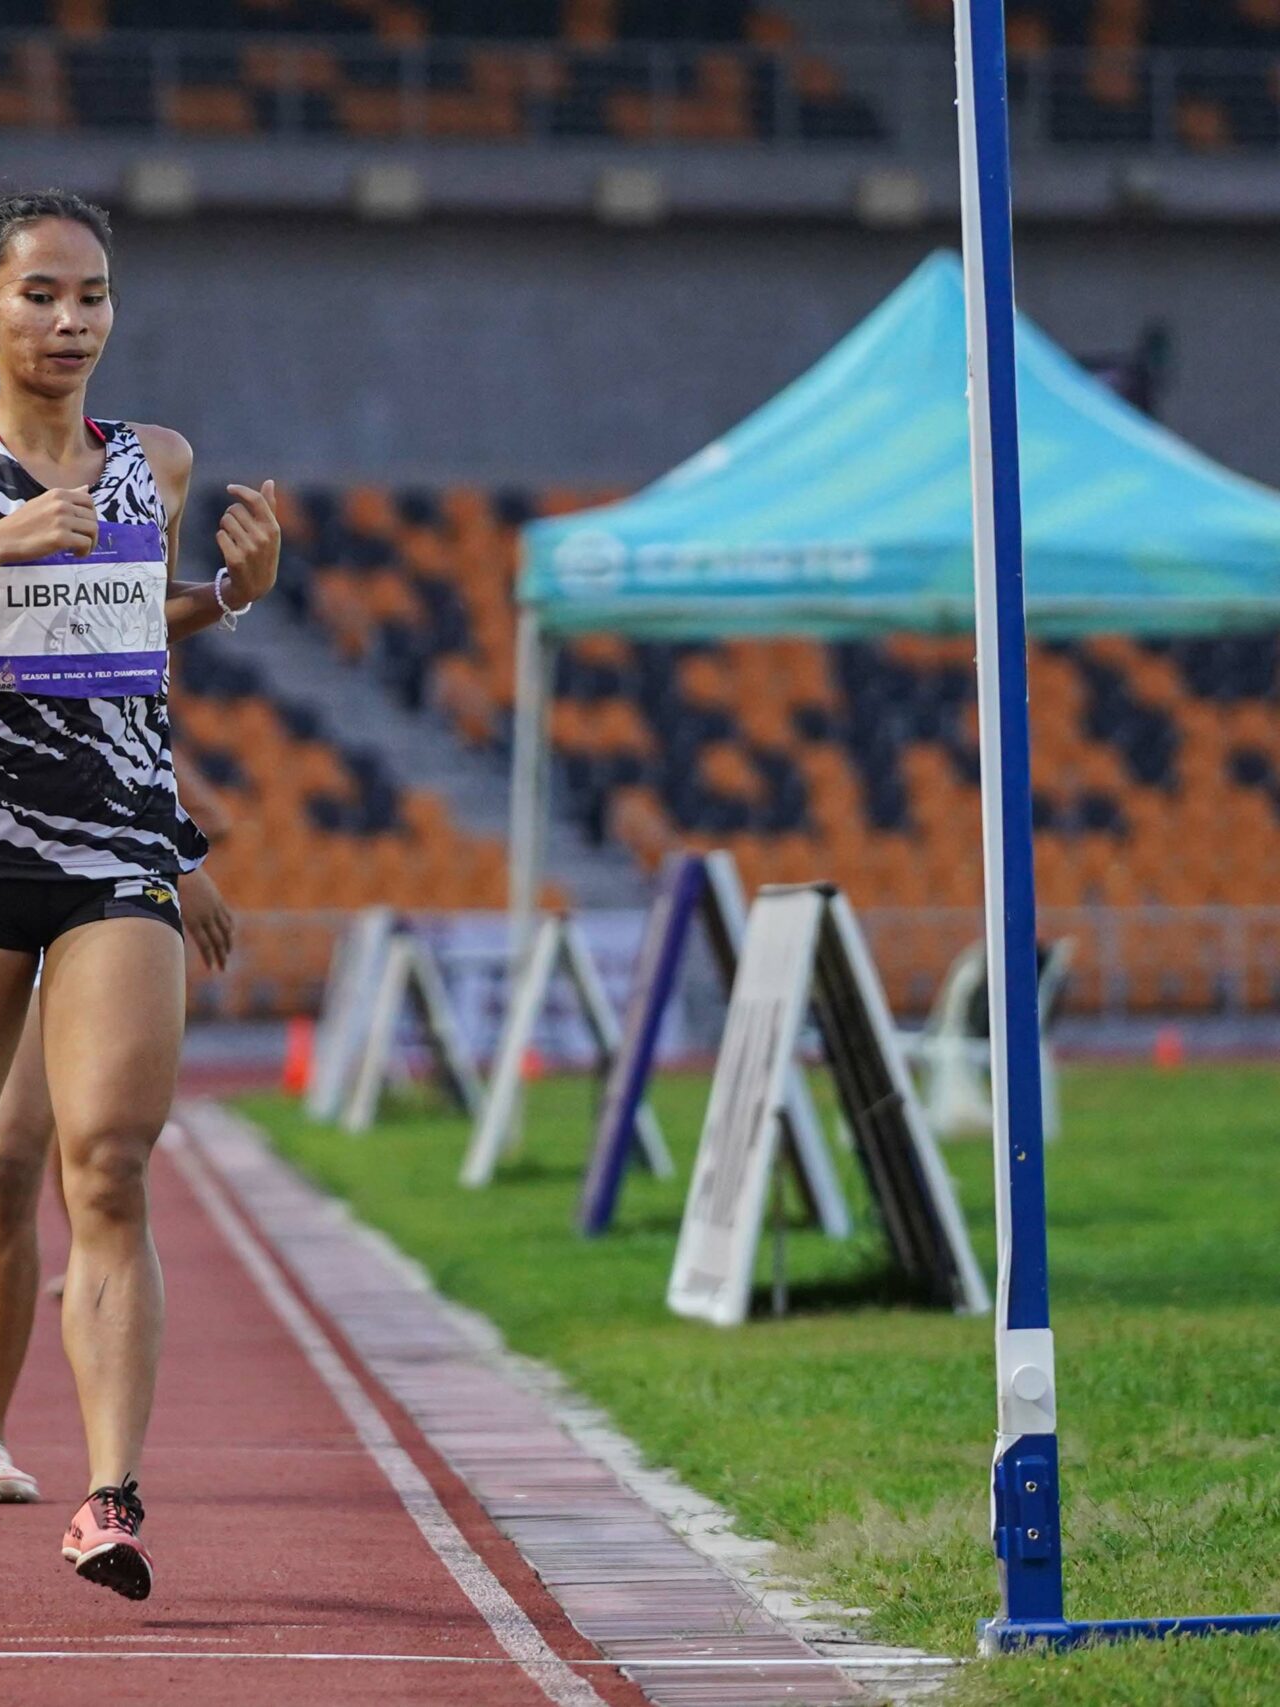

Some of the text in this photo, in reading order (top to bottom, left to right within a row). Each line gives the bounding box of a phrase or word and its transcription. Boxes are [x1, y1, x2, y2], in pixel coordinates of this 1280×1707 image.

[7, 581, 146, 608] LIBRANDA
[70, 623, 91, 635] 767
[21, 673, 50, 681] SEASON
[87, 671, 93, 679] &
[114, 669, 158, 678] CHAMPIONSHIPS
